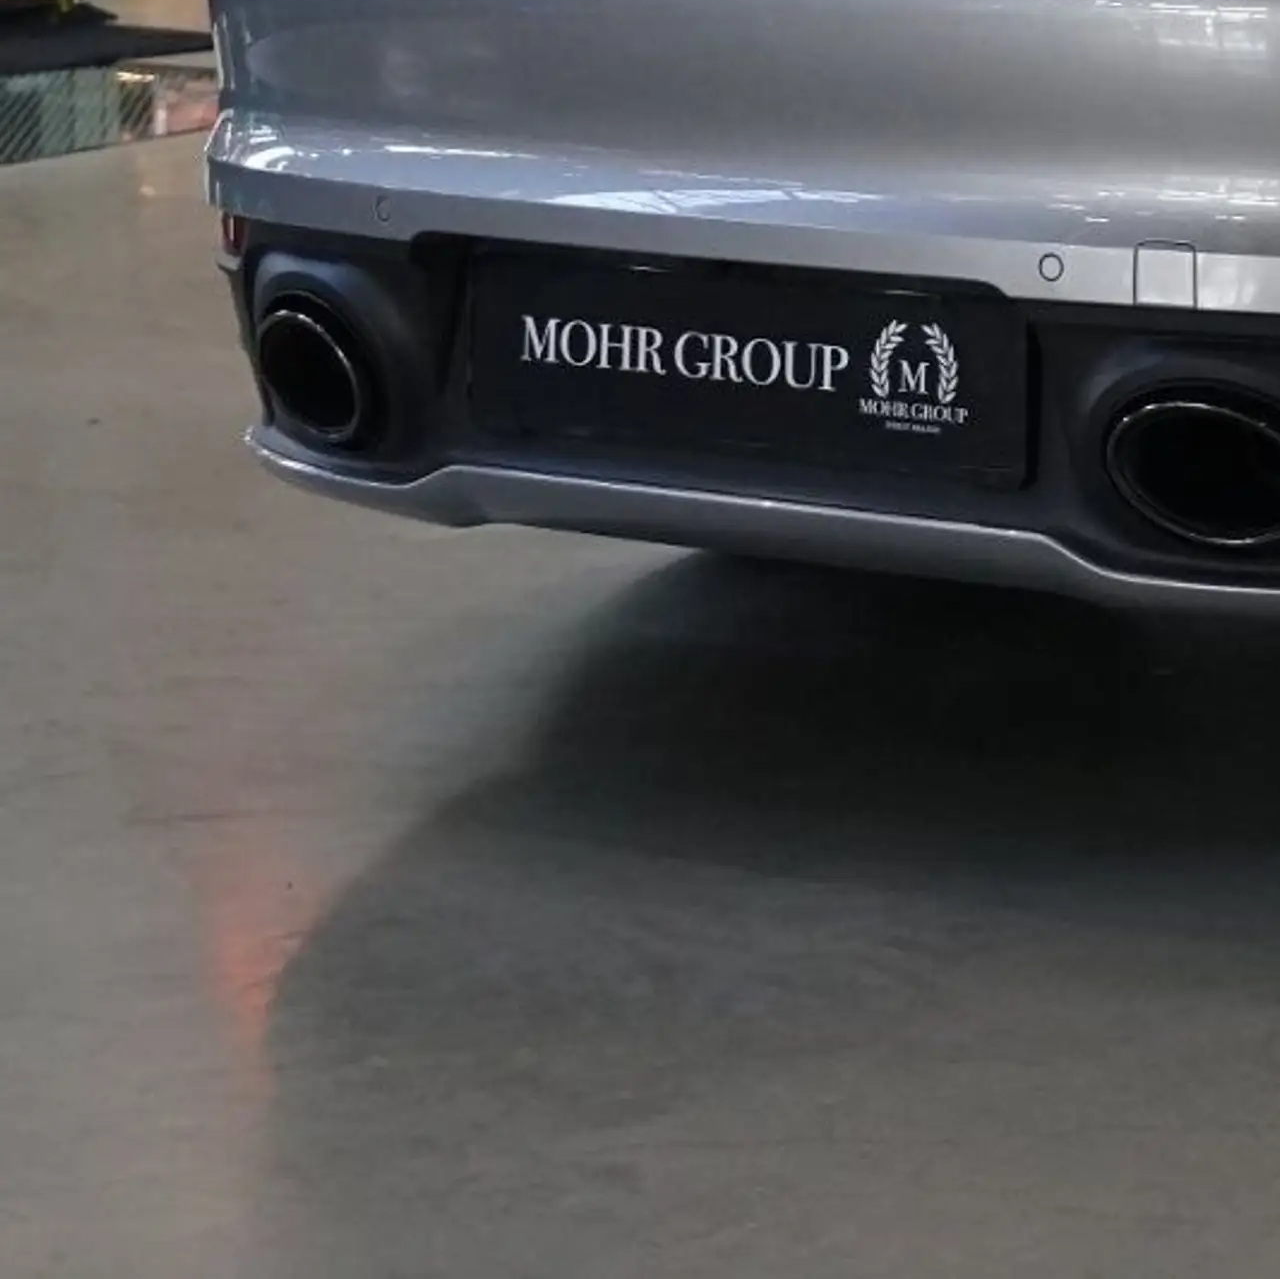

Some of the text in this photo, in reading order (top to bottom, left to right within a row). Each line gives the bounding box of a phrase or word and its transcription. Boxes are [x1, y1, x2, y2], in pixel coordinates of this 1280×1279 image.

[521, 315, 849, 392] MOHR GROUP
[898, 359, 930, 395] M
[859, 398, 969, 424] MOHR GROUP
